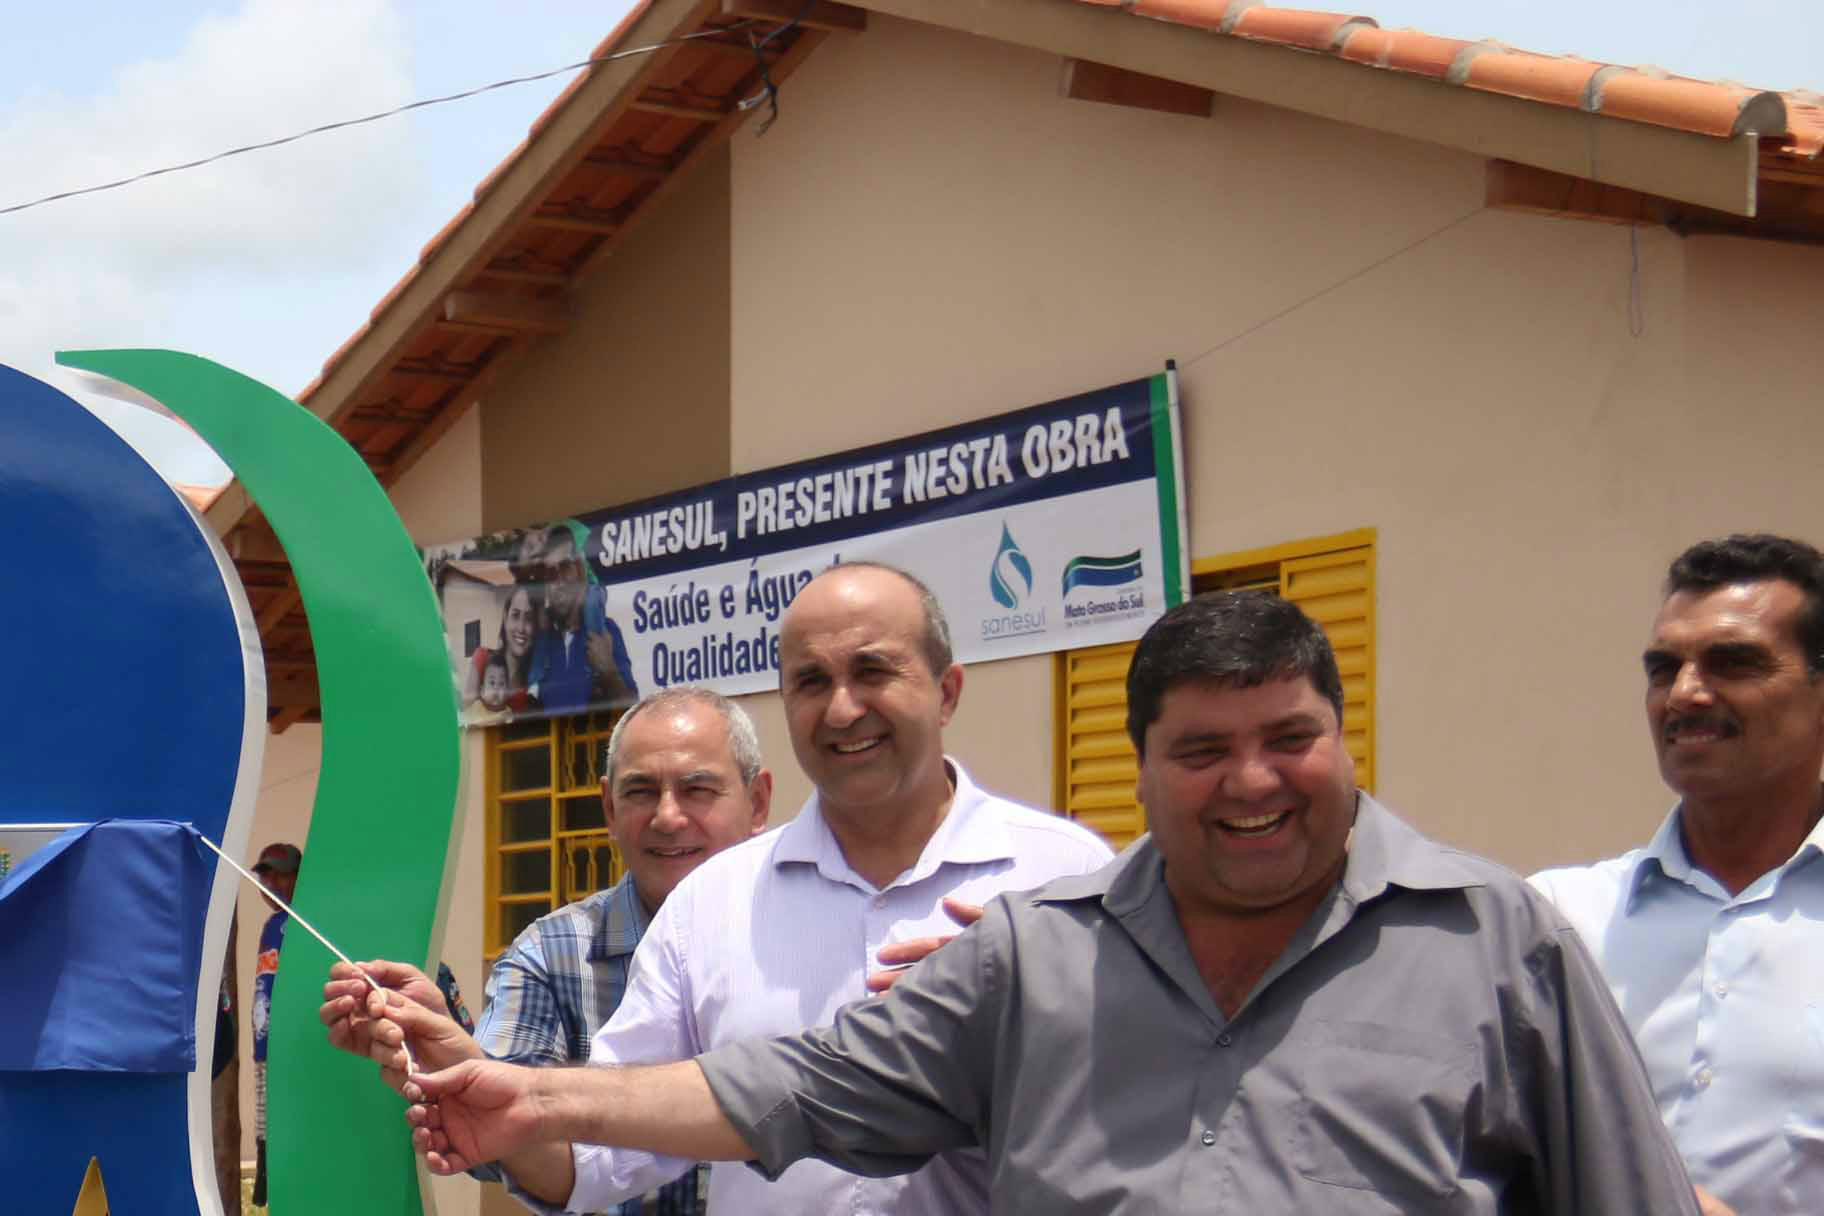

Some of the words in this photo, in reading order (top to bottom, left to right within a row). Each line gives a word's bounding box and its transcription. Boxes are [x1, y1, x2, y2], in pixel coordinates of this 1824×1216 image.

[599, 500, 727, 568] SANESUL,
[736, 459, 894, 540] PRESENTE
[902, 433, 1014, 505] NESTA
[1021, 406, 1130, 479] OBRA
[632, 581, 711, 634] Saúde
[719, 583, 736, 619] e
[981, 607, 1046, 636] sanesul
